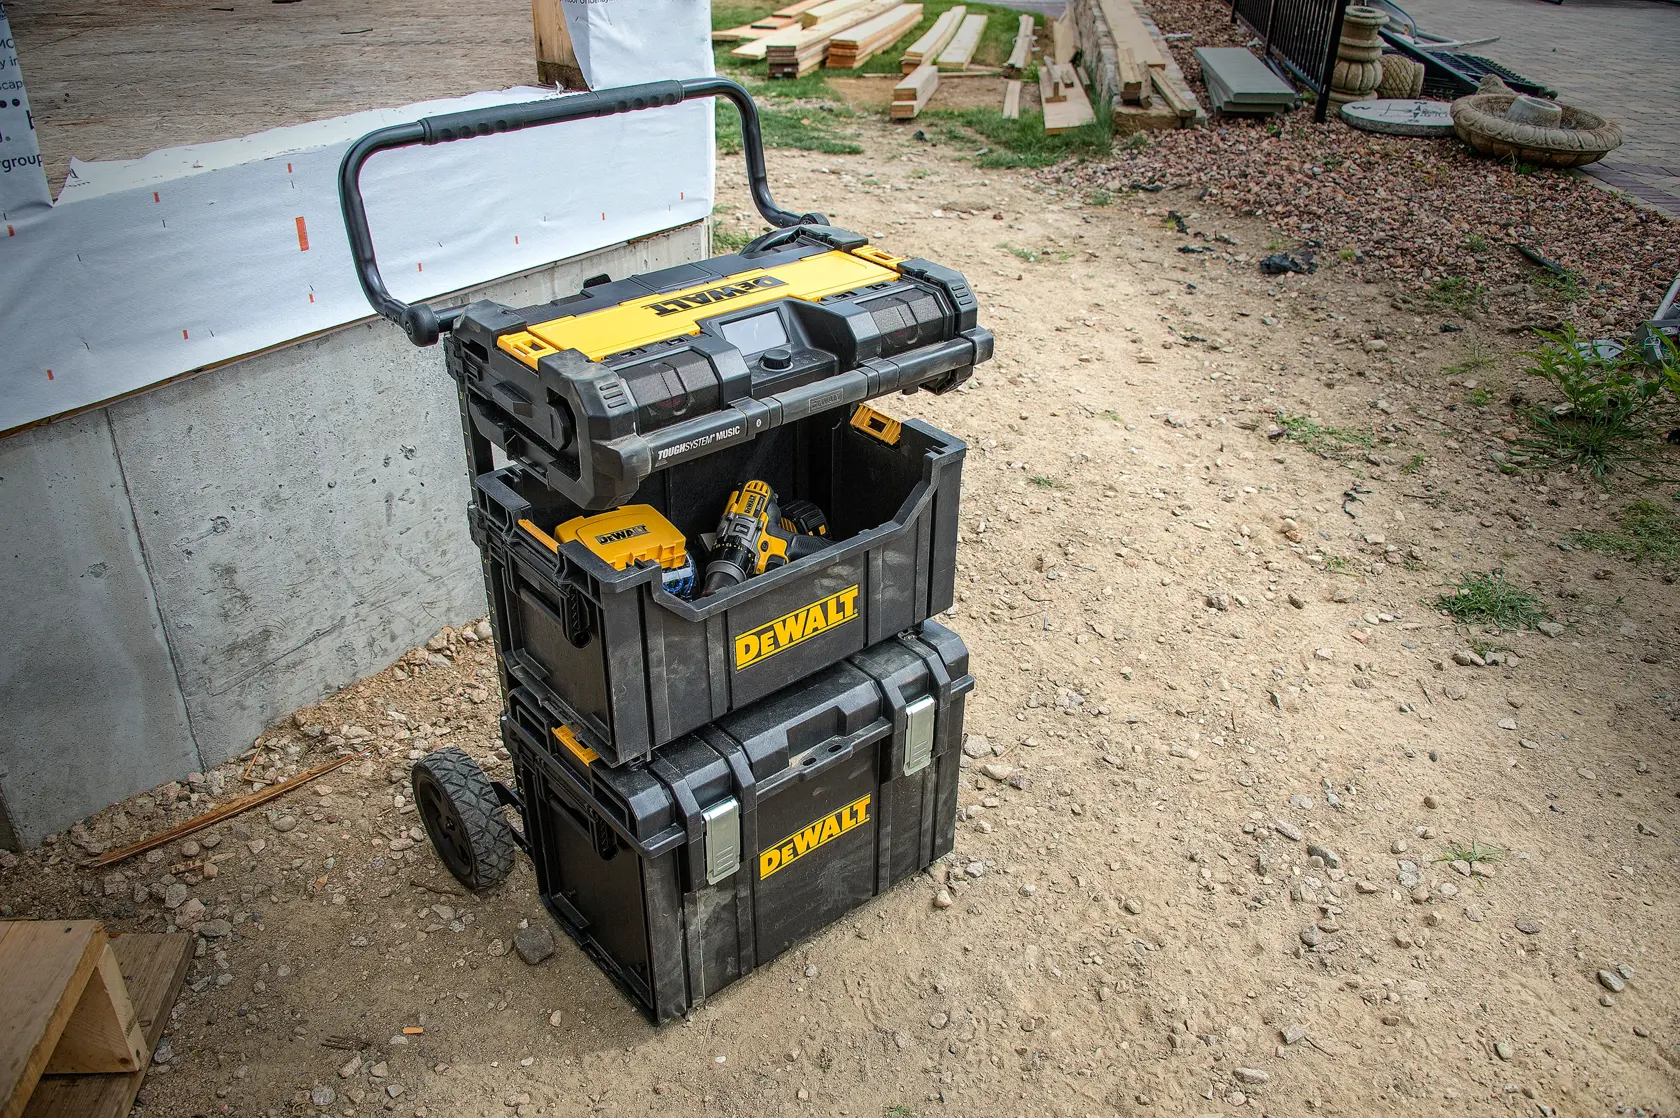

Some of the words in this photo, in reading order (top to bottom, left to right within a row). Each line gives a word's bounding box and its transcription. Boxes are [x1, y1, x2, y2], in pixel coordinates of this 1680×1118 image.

[648, 275, 789, 317] DEWALT
[715, 425, 741, 442] MUSIC
[595, 524, 651, 545] DEWALT
[735, 588, 859, 668] DEWALT
[760, 796, 871, 878] DEWALT
